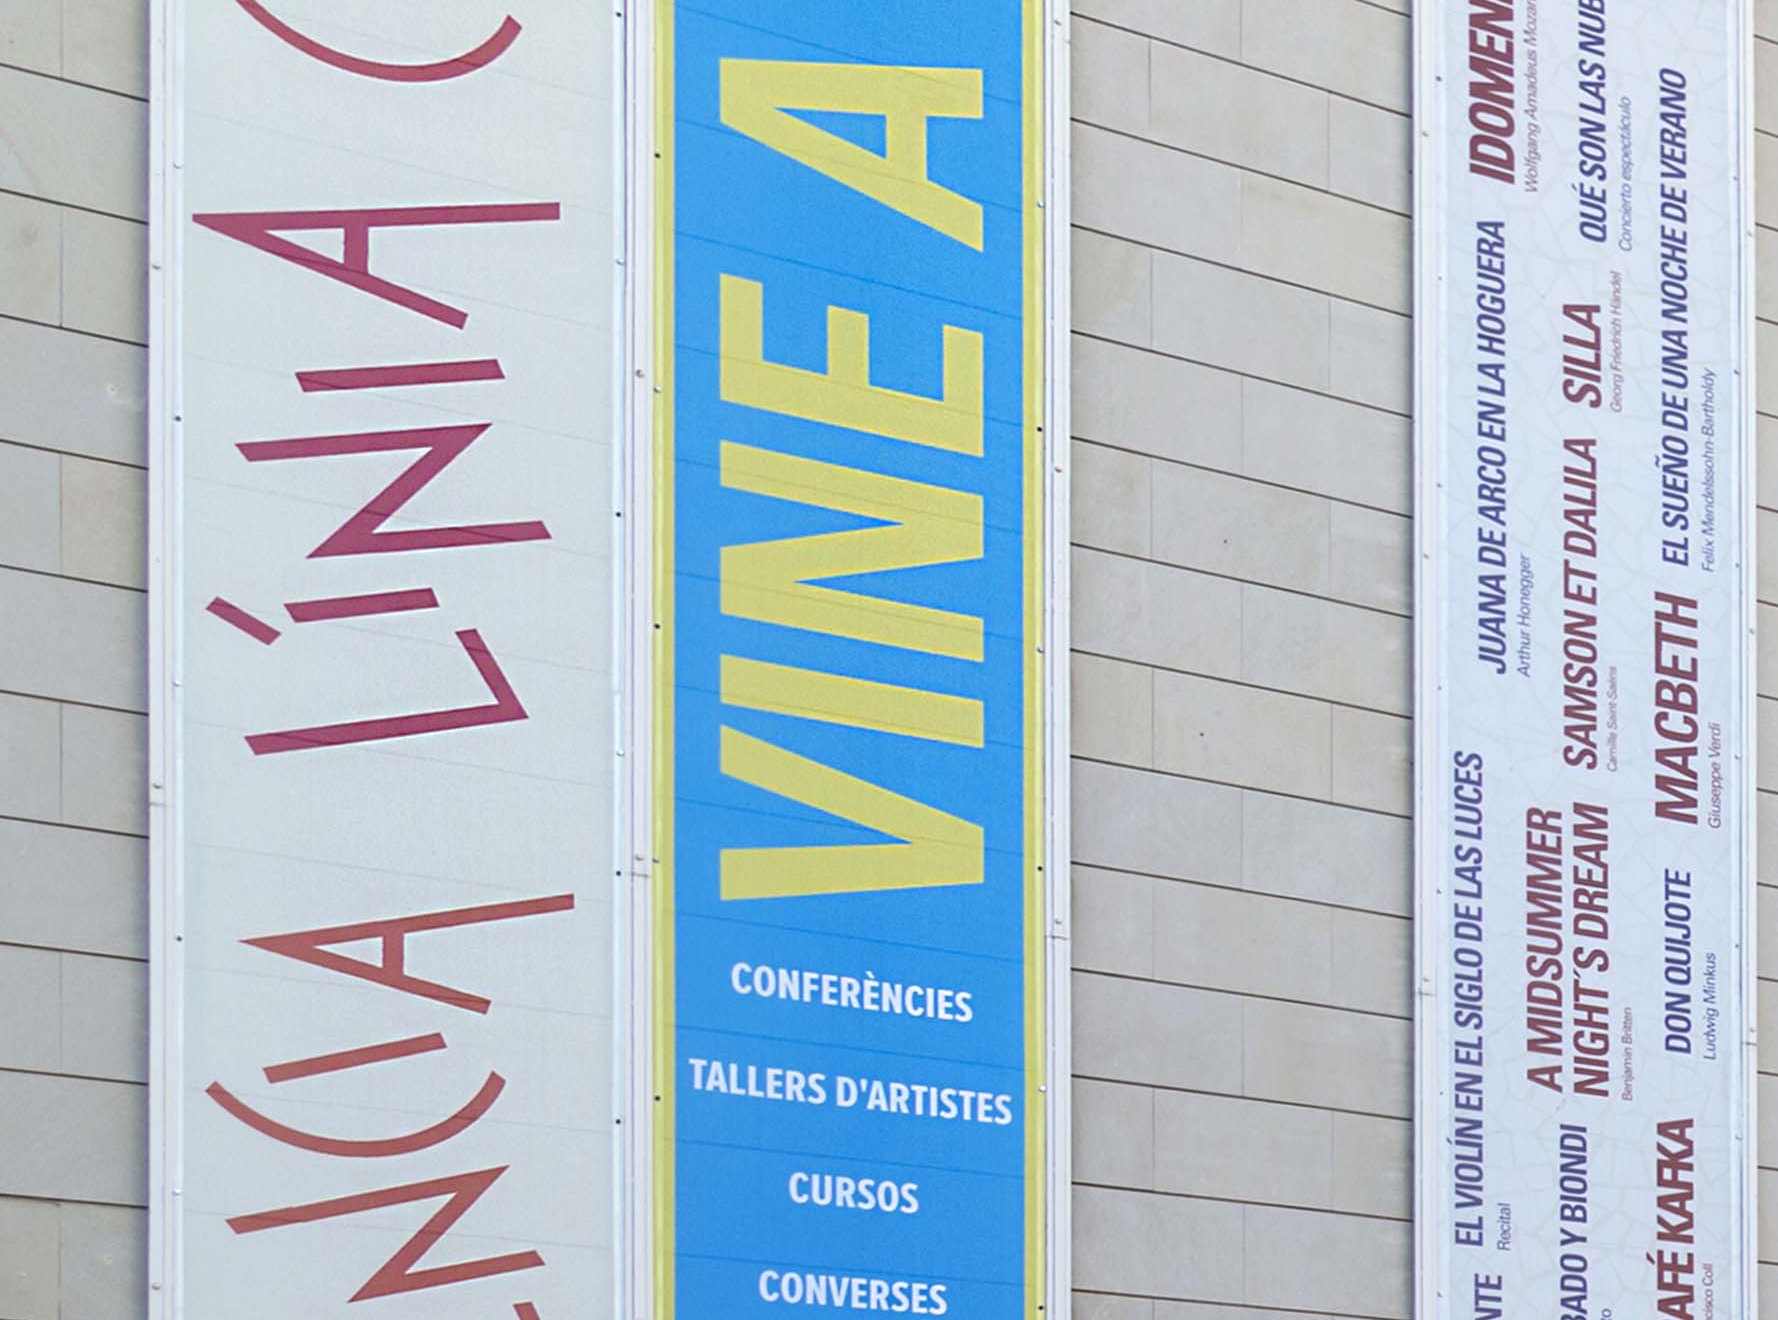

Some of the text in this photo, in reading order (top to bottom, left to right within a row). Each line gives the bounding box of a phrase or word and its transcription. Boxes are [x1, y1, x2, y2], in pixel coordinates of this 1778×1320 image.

[1578, 58, 1606, 115] LAS
[719, 57, 984, 253] A
[1579, 116, 1606, 181] SON
[1571, 182, 1607, 243] QUÉ
[1563, 303, 1601, 408] SILLA
[1655, 67, 1689, 567] EL SUEÑO DE UNA NOCHE DE VERANO
[1477, 220, 1506, 675] JUANA DE ARCO EN LA HOGUERA
[719, 274, 985, 901] VINE
[1563, 438, 1597, 770] SAMSON ET DALILA
[1517, 629, 1530, 678] Arthur
[1655, 591, 1698, 825] MACBETH
[1573, 802, 1609, 940] DREAM
[731, 962, 973, 1022] CONFERÈNCIES
[1447, 750, 1483, 1247] EL VIOLÍN EN EL SIGLO DE LAS LUCES
[1526, 807, 1563, 1093] A MIDSUMMER
[1665, 868, 1693, 1054] DON QUIJOTE
[1703, 953, 1716, 1005] Minkus
[688, 1058, 1012, 1125] TALLERS D'ARTISTES
[788, 1171, 919, 1214] CURSOS
[1560, 1124, 1588, 1224] BIONDI
[1657, 1118, 1694, 1244] KAFKA
[1560, 1229, 1588, 1248] Y
[758, 1270, 947, 1315] CONVERSES
